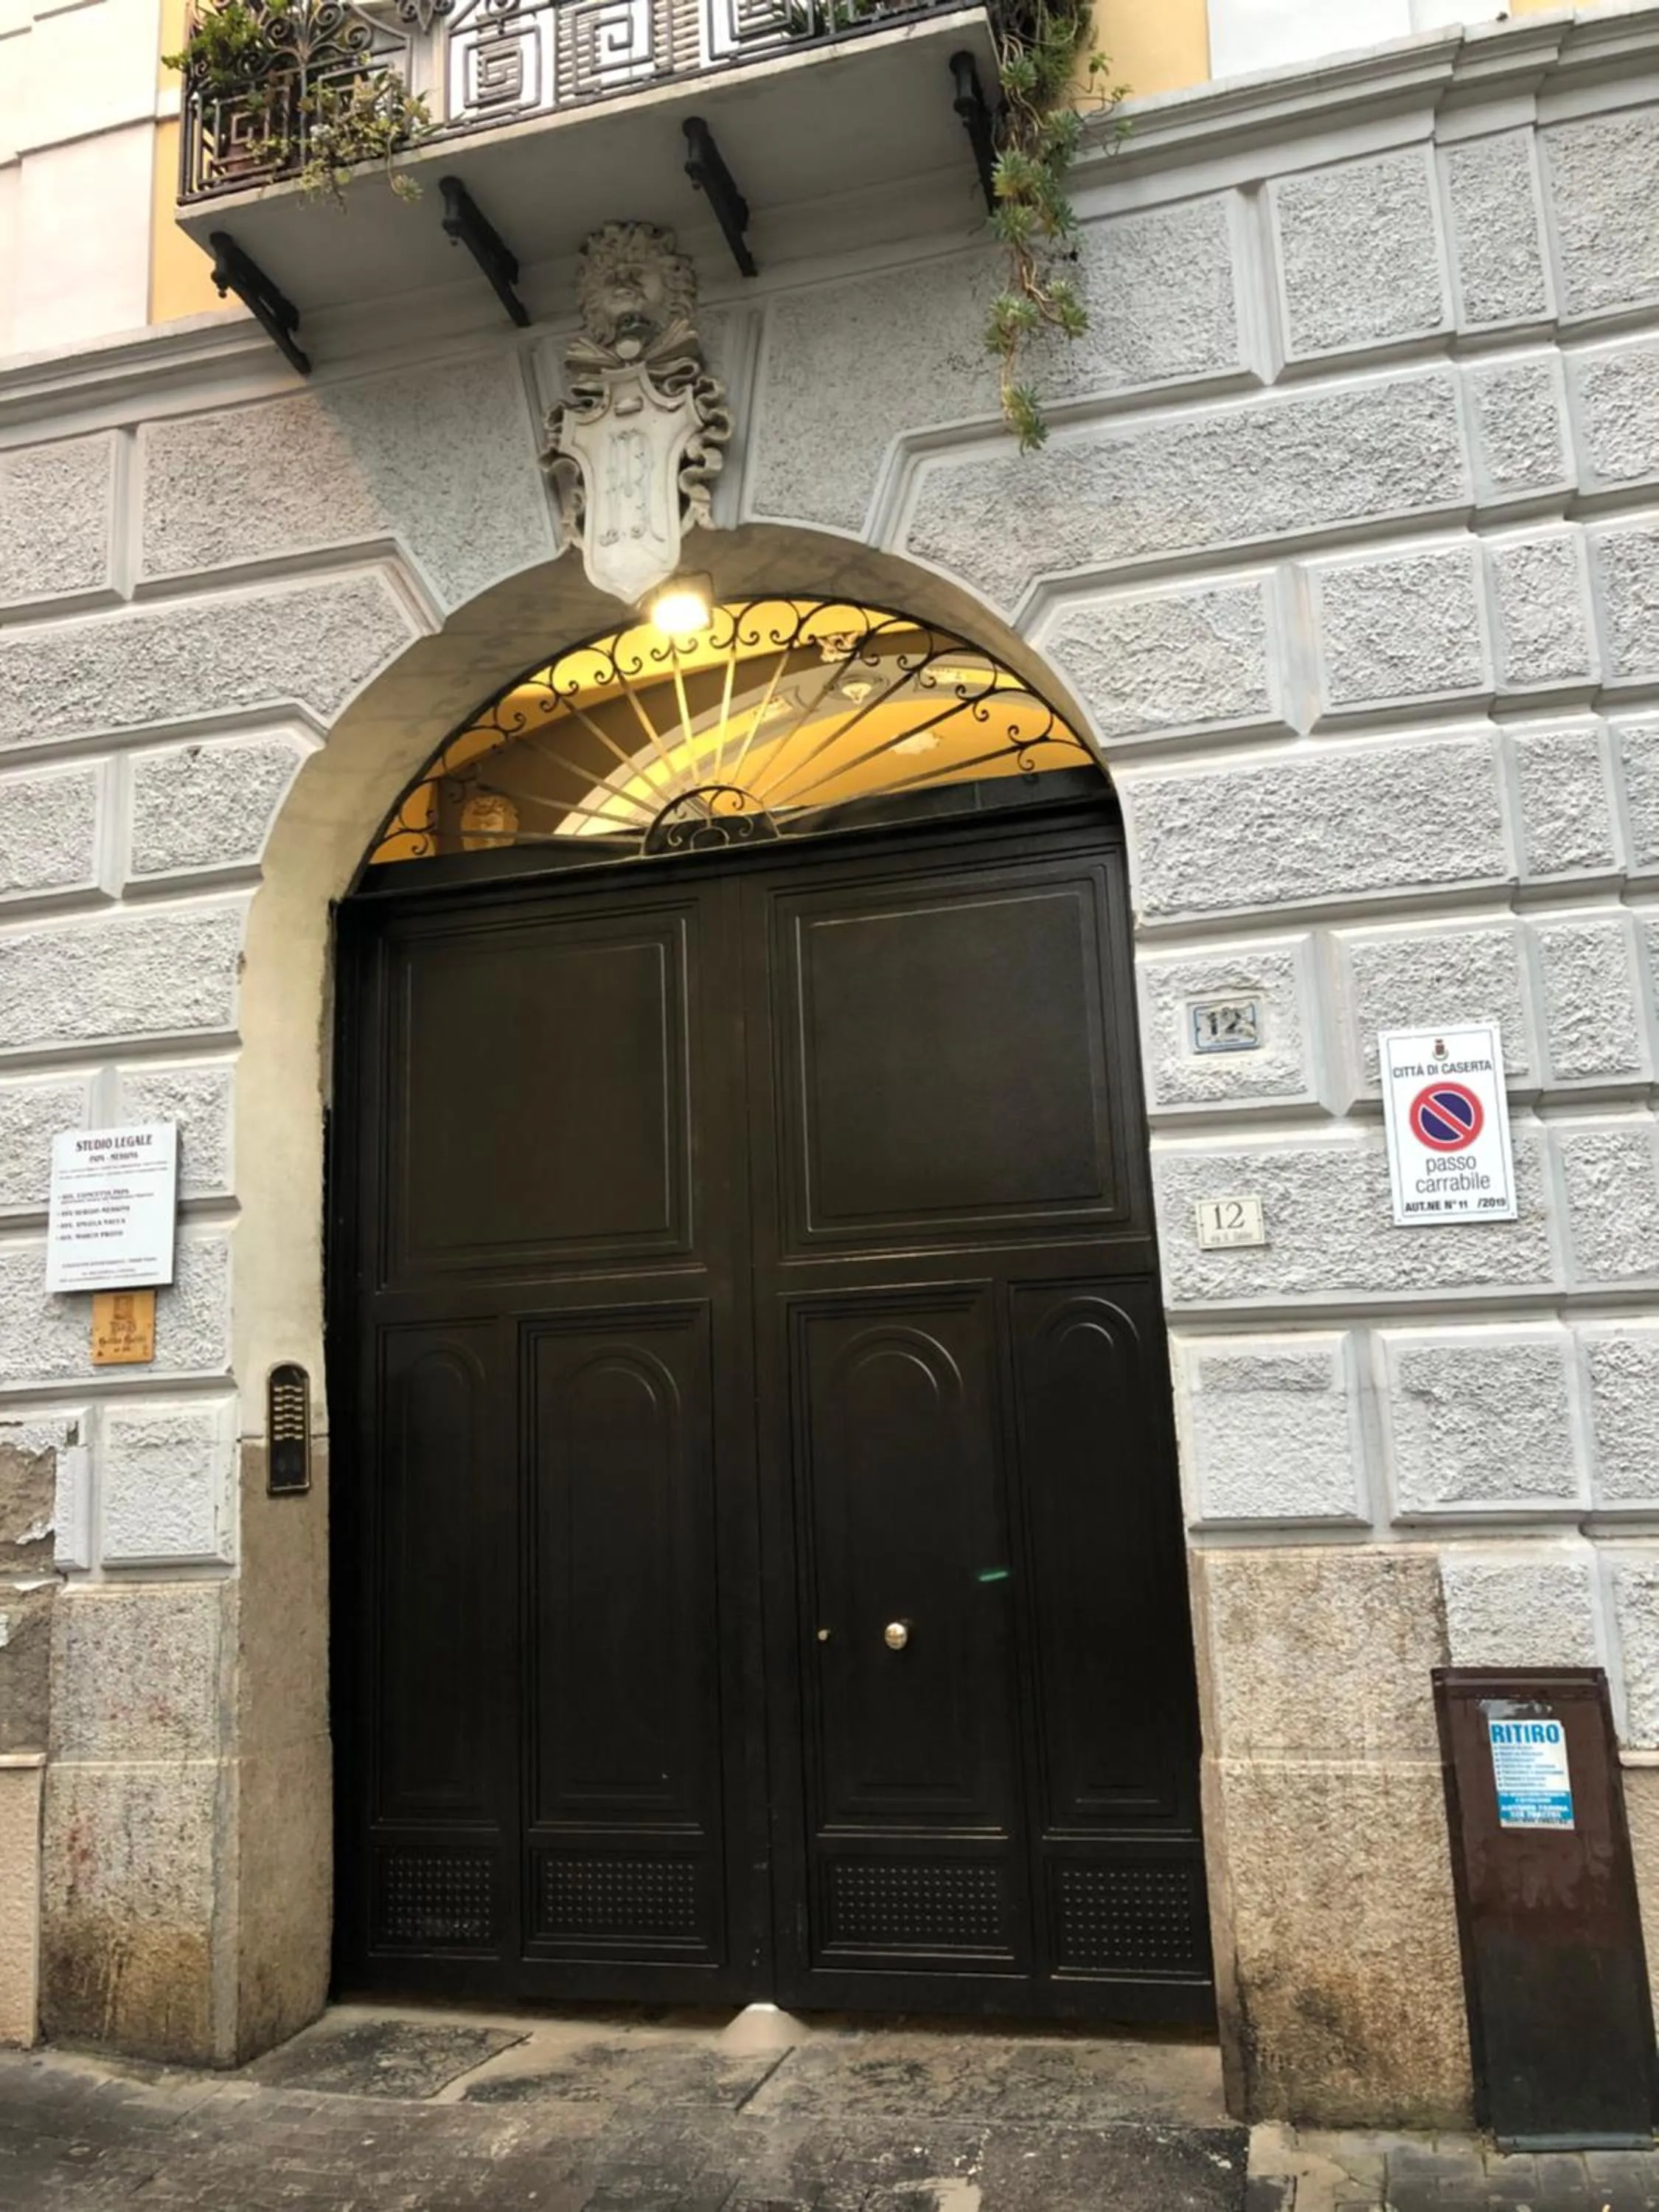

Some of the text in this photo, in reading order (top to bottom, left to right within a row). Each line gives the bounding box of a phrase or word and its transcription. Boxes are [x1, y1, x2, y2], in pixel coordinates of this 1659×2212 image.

[1427, 1064, 1439, 1075] DI
[1441, 1060, 1492, 1074] CASERTA
[76, 1134, 153, 1151] STUDIO LEGALE
[1426, 1155, 1478, 1175] passo
[1416, 1173, 1491, 1193] carrabile
[1405, 1200, 1441, 1212] AUT.NE
[1214, 1202, 1245, 1230] 12
[1491, 1724, 1559, 1743] RITIRO
